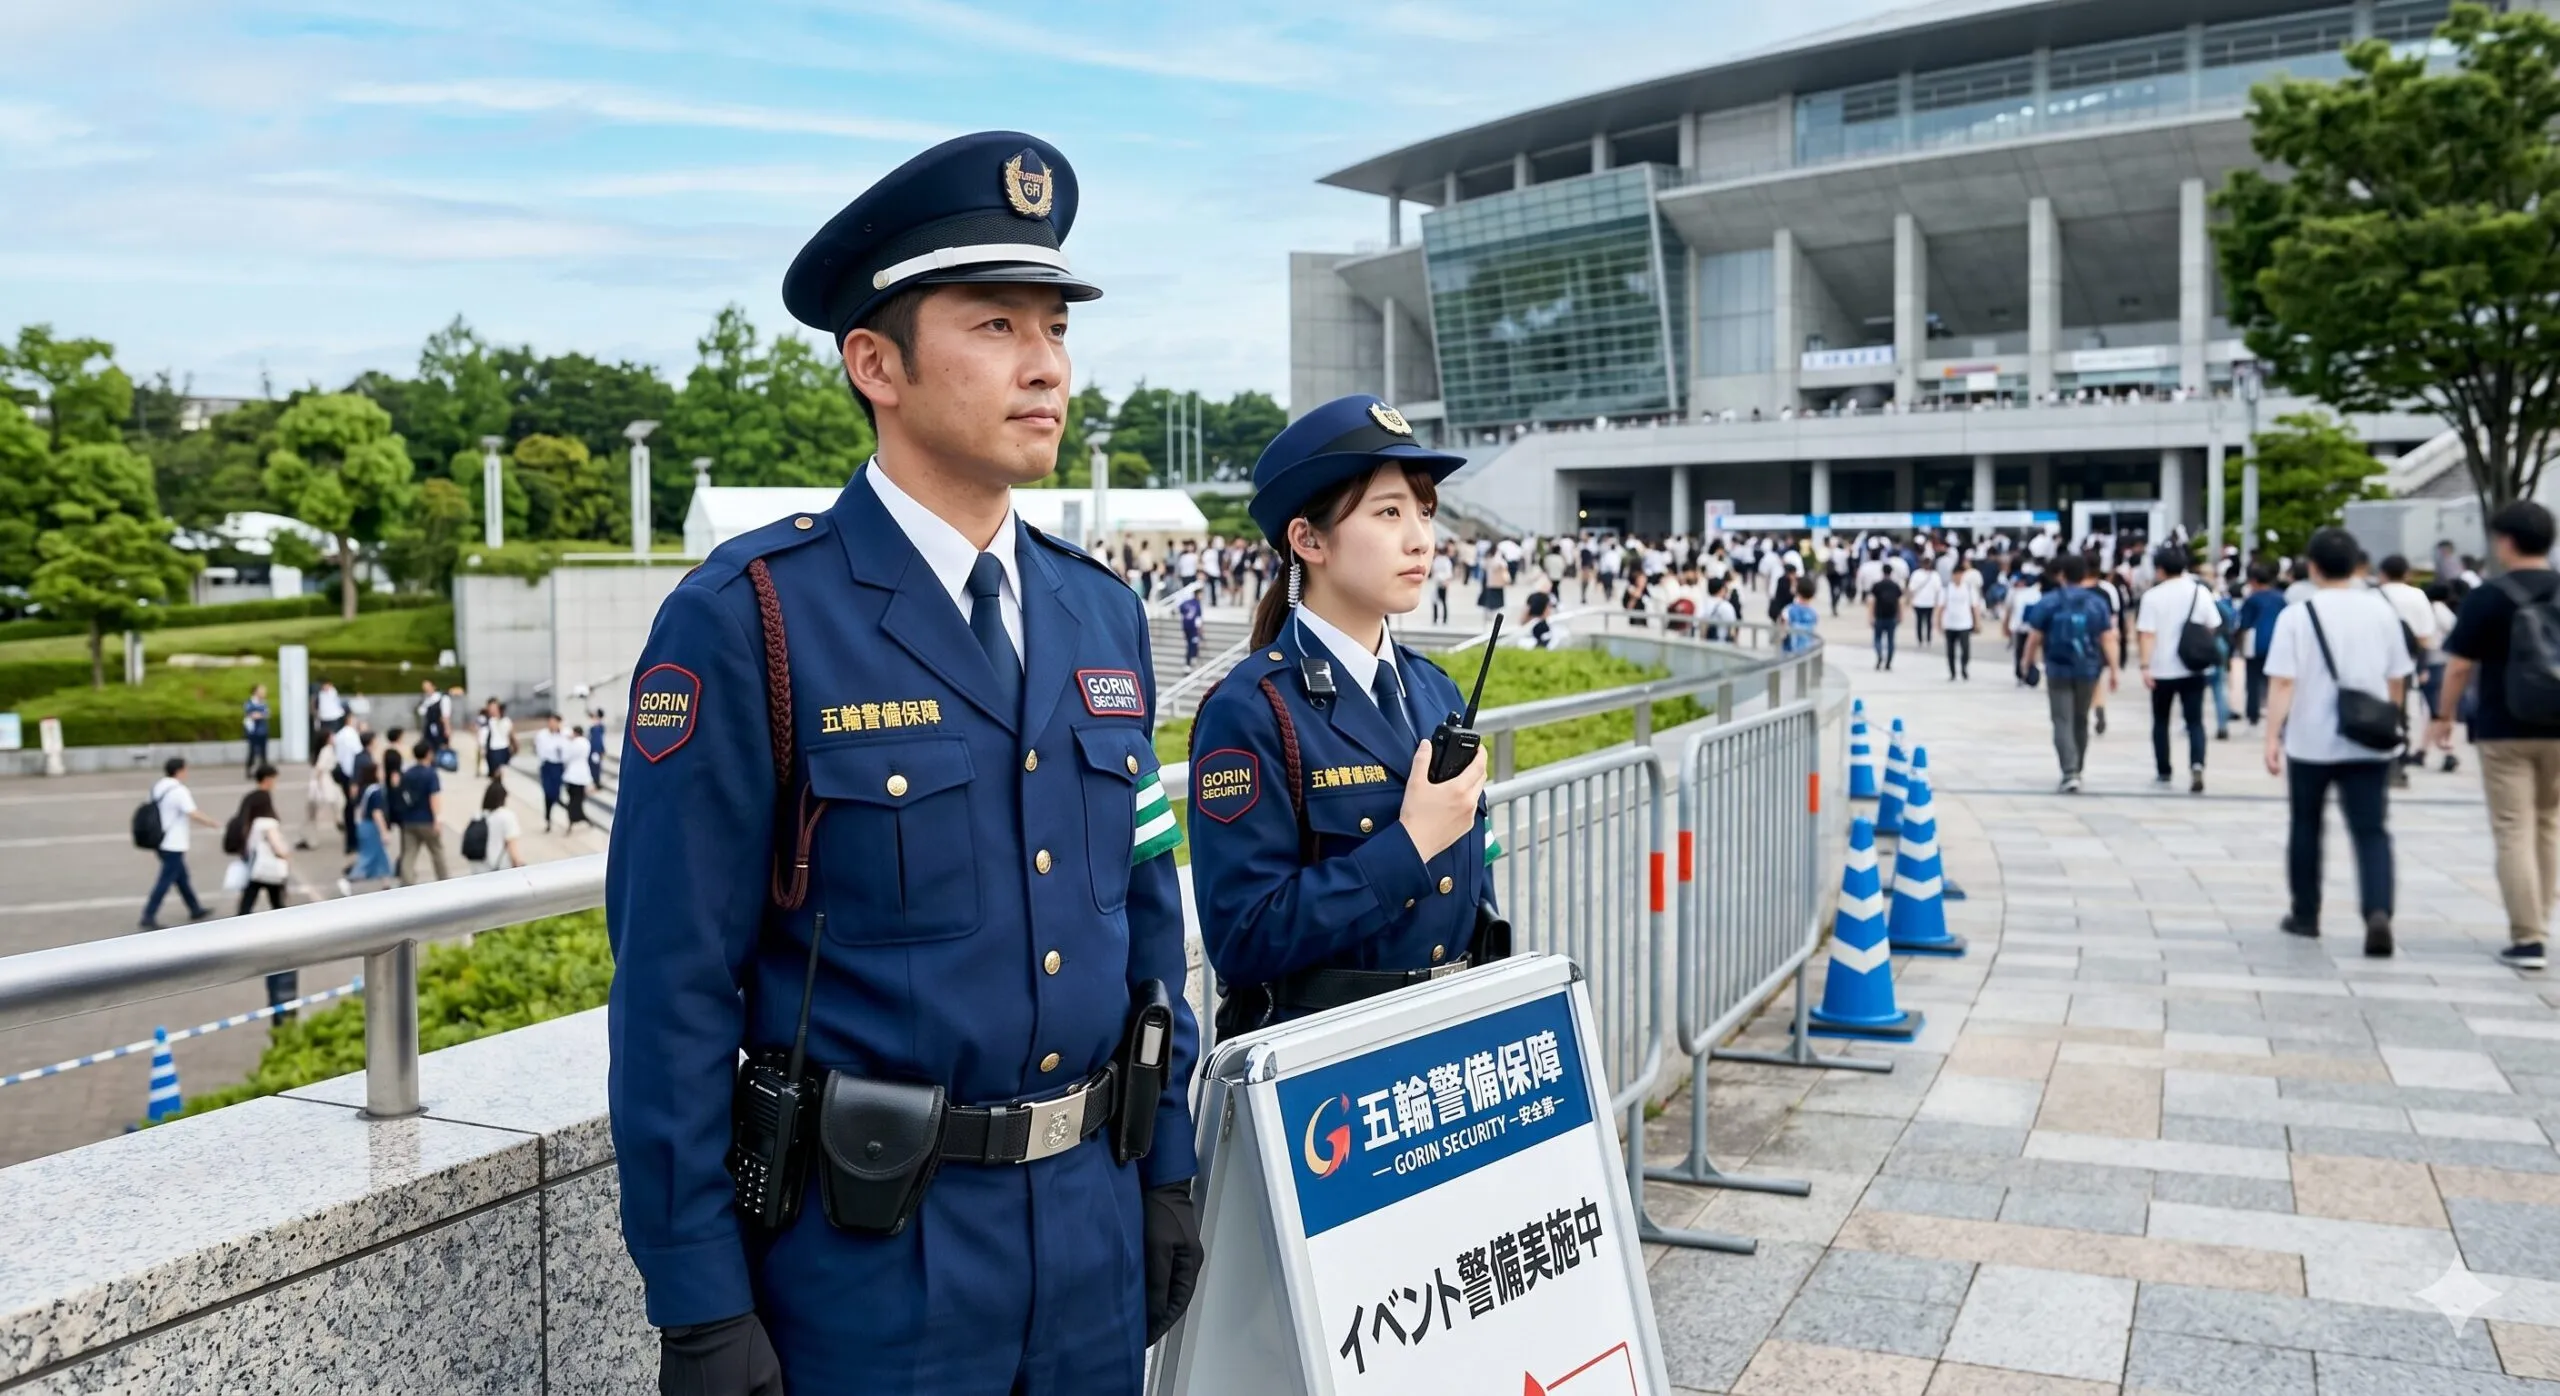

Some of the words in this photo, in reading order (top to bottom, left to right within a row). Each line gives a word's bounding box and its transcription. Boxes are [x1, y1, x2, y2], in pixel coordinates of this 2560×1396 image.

[1087, 677, 1136, 696] GORIN
[640, 692, 690, 712] GORIN
[636, 713, 687, 729] SECURITY
[820, 699, 942, 733] 五輪警備保障
[1202, 767, 1251, 788] GORIN
[1202, 783, 1252, 800] SECURITY
[1356, 1029, 1564, 1152] 五輪警備保障
[1394, 1139, 1441, 1176] GORIN
[1442, 1113, 1507, 1158] SECURITY
[1339, 1196, 1603, 1375] イベント警備実施中
